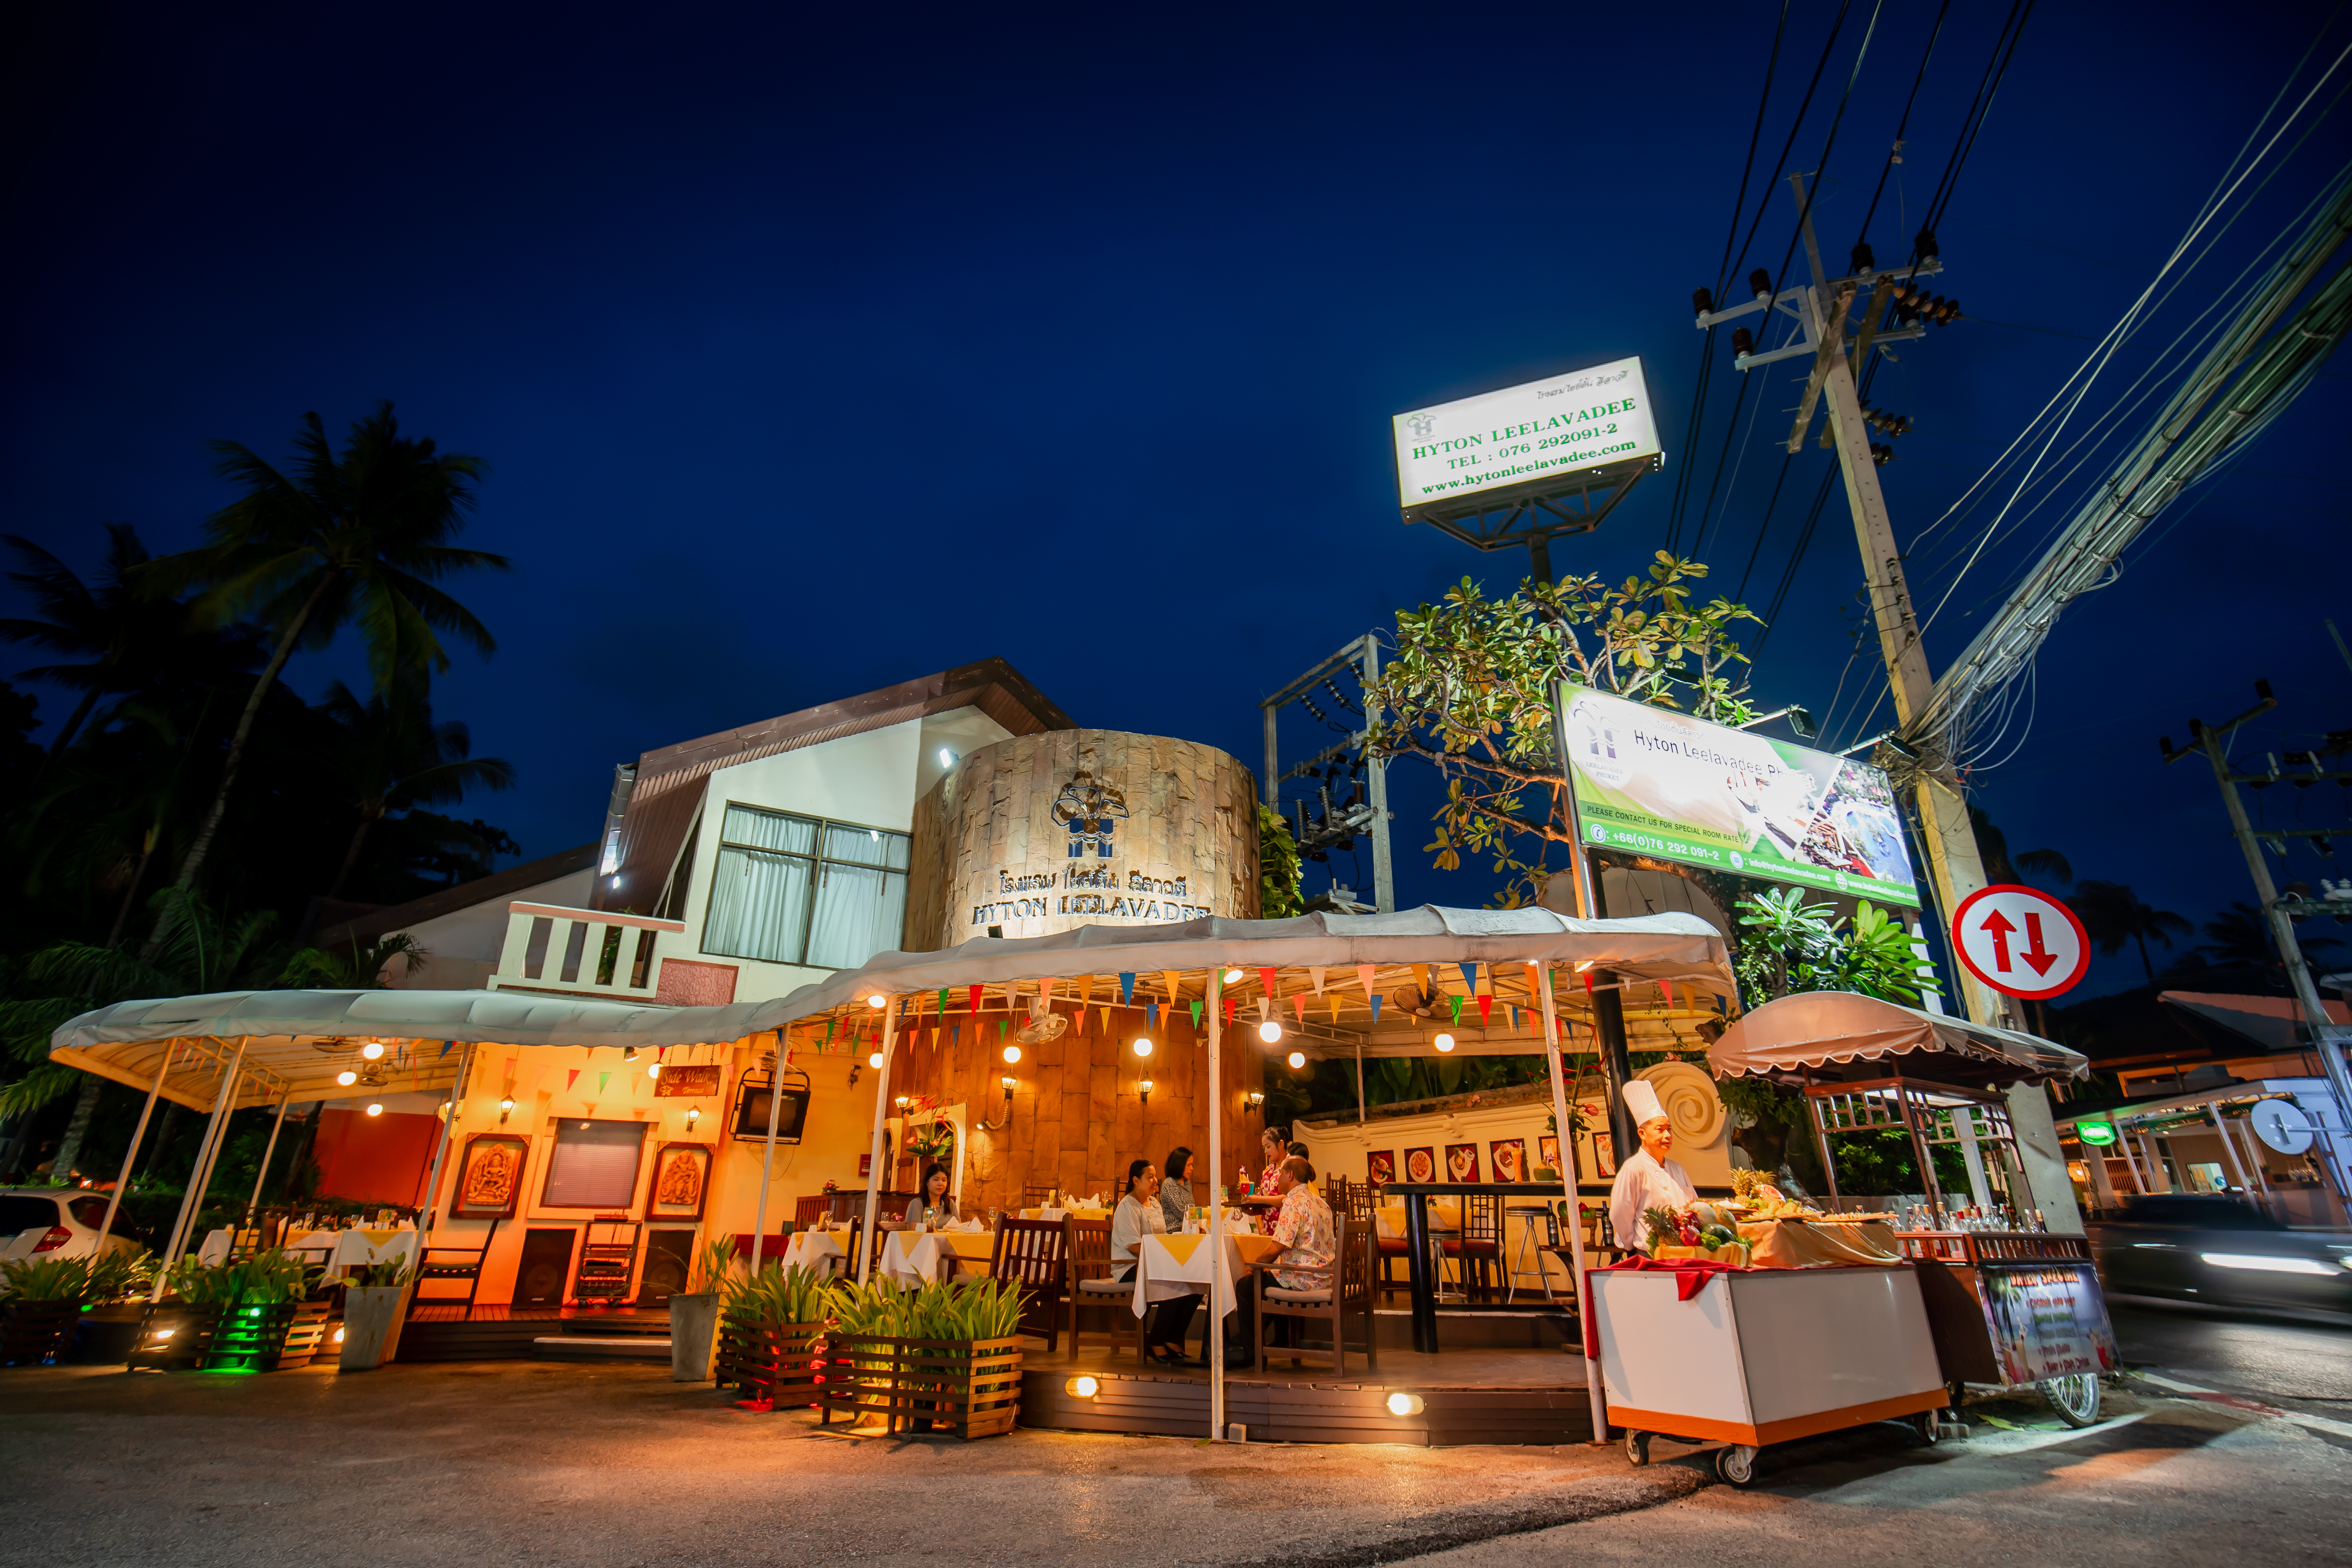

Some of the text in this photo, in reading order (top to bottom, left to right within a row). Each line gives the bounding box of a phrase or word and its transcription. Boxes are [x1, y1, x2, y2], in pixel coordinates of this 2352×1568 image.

[1412, 397, 1636, 459] HYTON LEELAVADEE
[1447, 455, 1481, 469] TEL
[1499, 443, 1531, 458] 076
[1538, 423, 1618, 450] 292091-2
[1422, 440, 1637, 494] www.hytonleelavadee.com
[1634, 729, 1818, 790] Hyton Leelavadee Phet
[1587, 805, 1739, 843] PLEASE CONTACT US FOR SPECIAL ROOM RATE
[1613, 832, 1664, 850] +66(0)76
[1666, 841, 1688, 855] 292
[1690, 846, 1720, 861] 091-2
[1748, 857, 1831, 882] info@hytonleelavadee.com
[972, 899, 1045, 925] HYTON
[661, 1068, 711, 1085] Side Walk
[2008, 1268, 2079, 1286] DAILY SPECIAL
